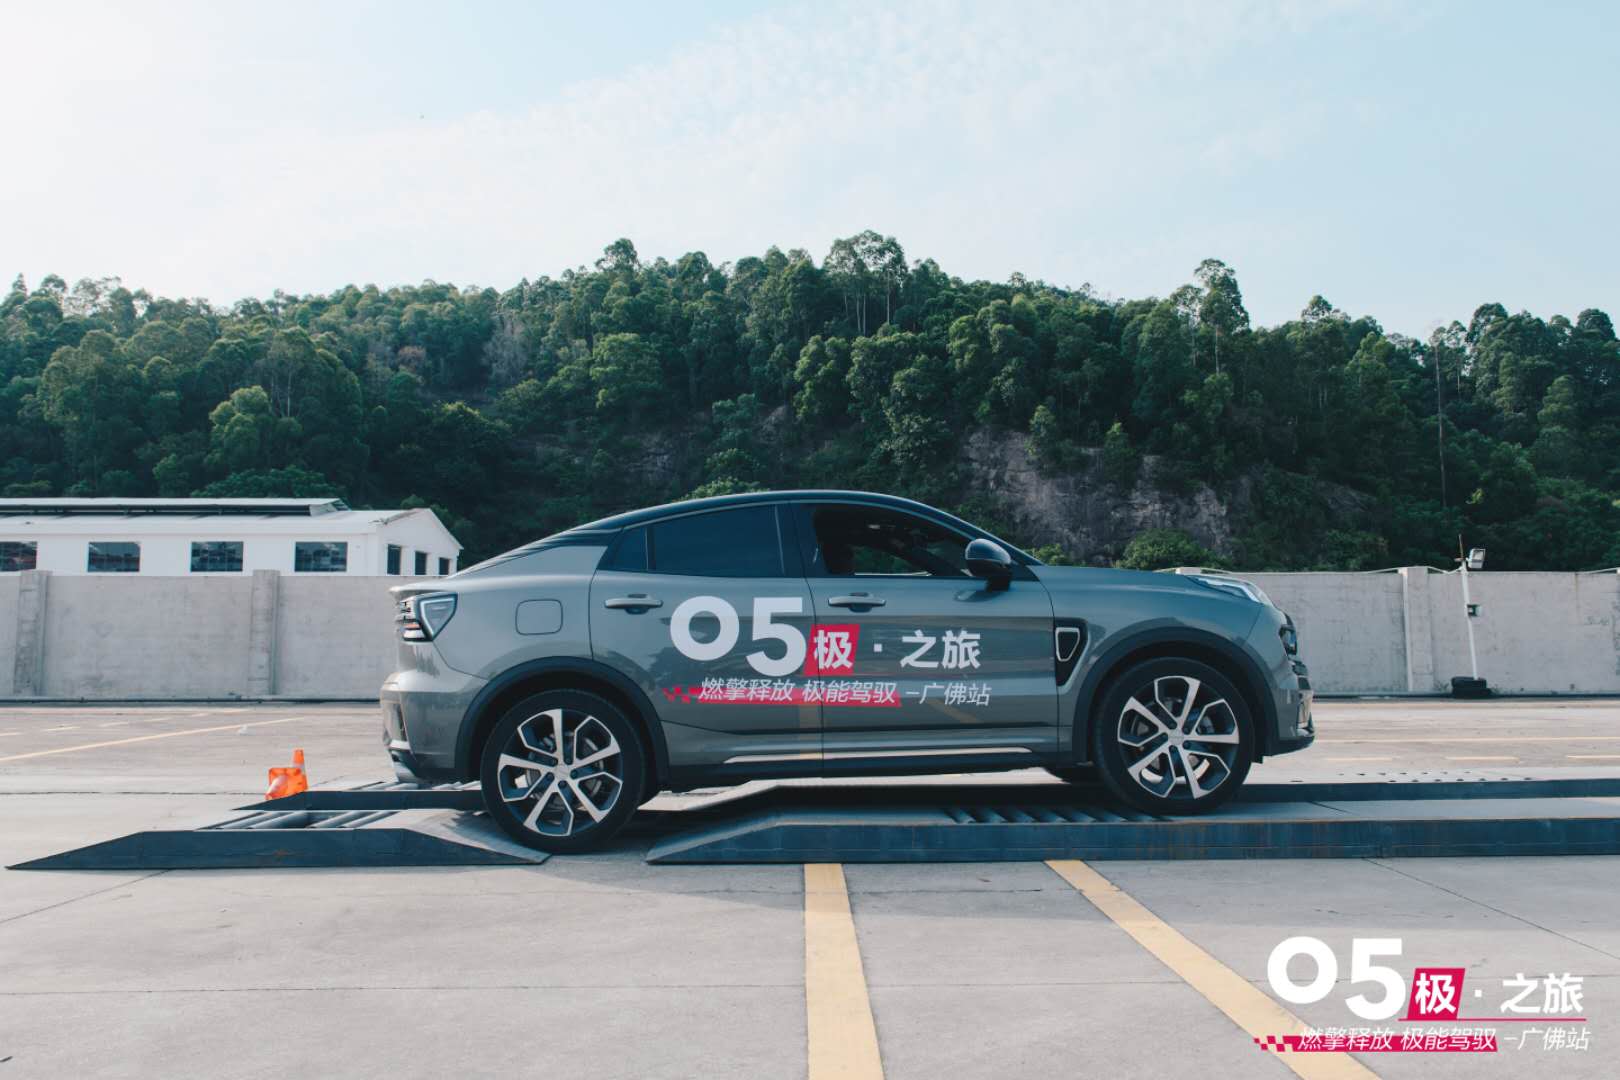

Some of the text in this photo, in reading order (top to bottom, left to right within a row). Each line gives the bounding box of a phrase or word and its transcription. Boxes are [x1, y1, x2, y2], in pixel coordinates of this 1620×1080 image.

[699, 677, 795, 702] 燃擎释放
[801, 678, 898, 704] 极能驾驭
